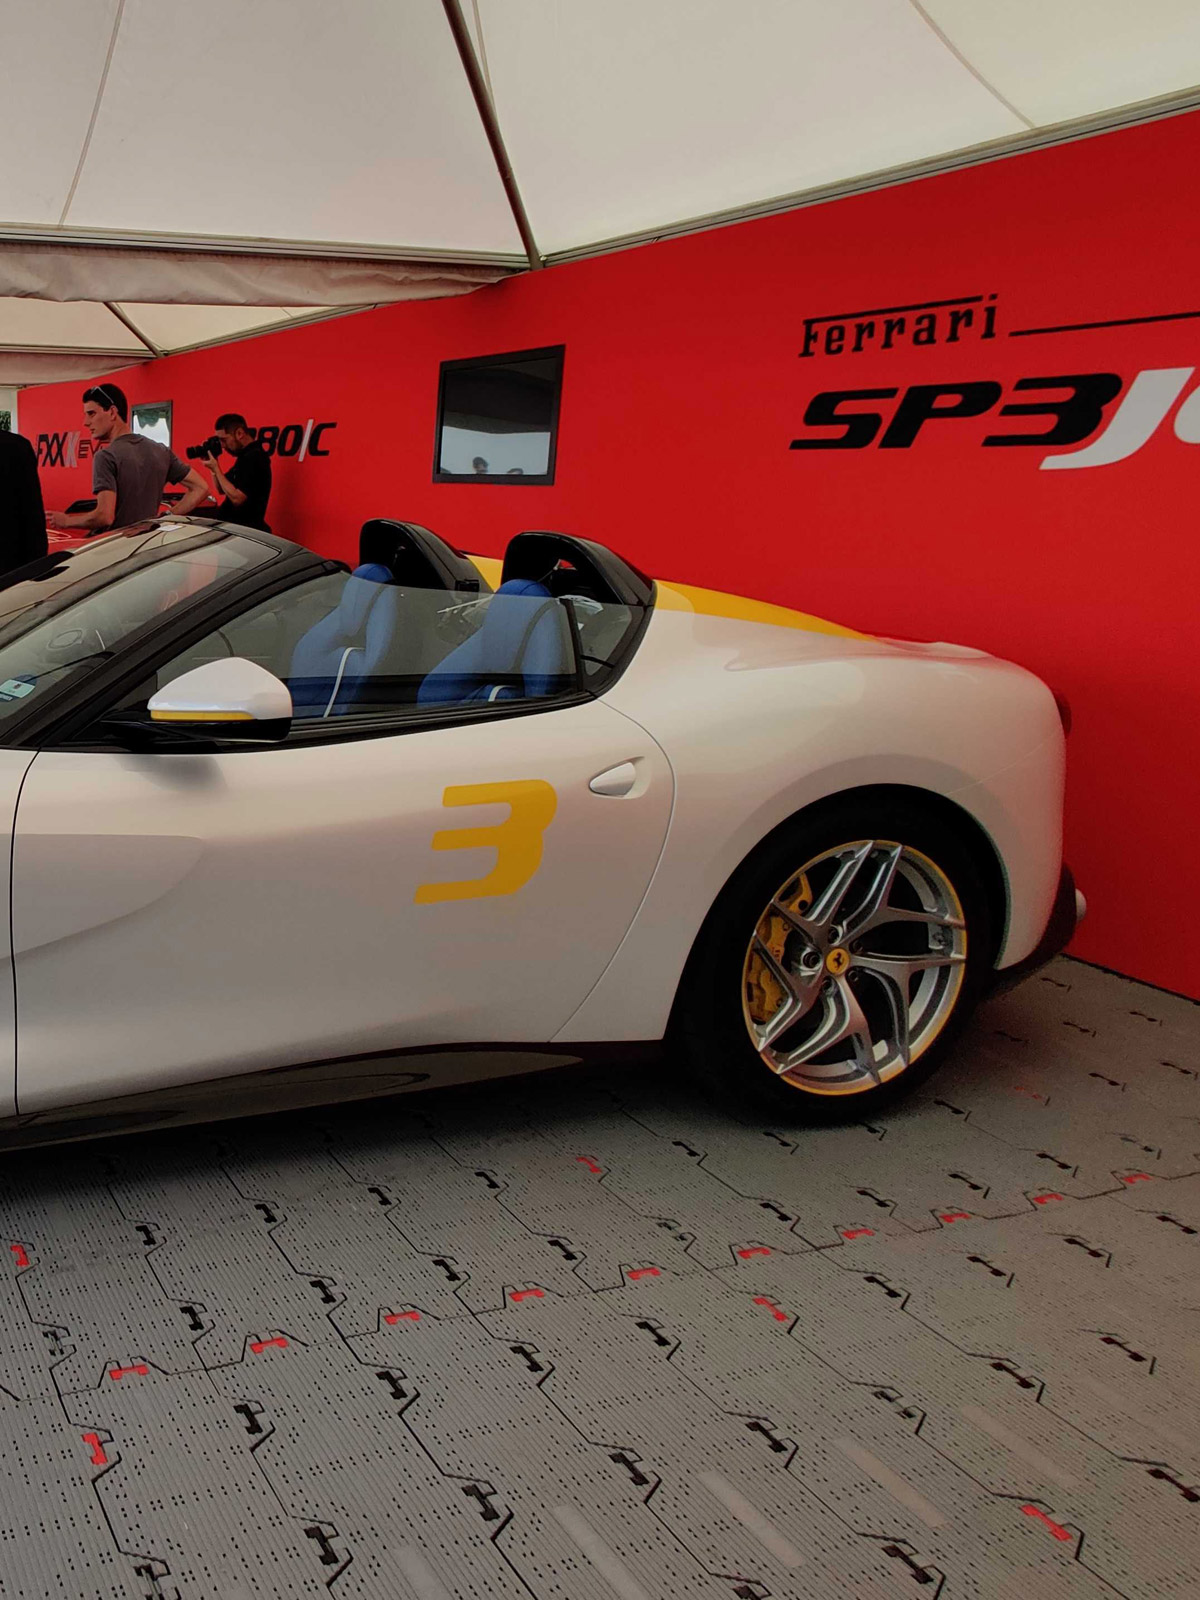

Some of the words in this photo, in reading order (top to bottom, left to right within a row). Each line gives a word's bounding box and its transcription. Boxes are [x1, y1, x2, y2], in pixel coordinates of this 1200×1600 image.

[798, 293, 999, 358] Ferrari
[78, 439, 111, 459] EV
[413, 779, 558, 905] 3
